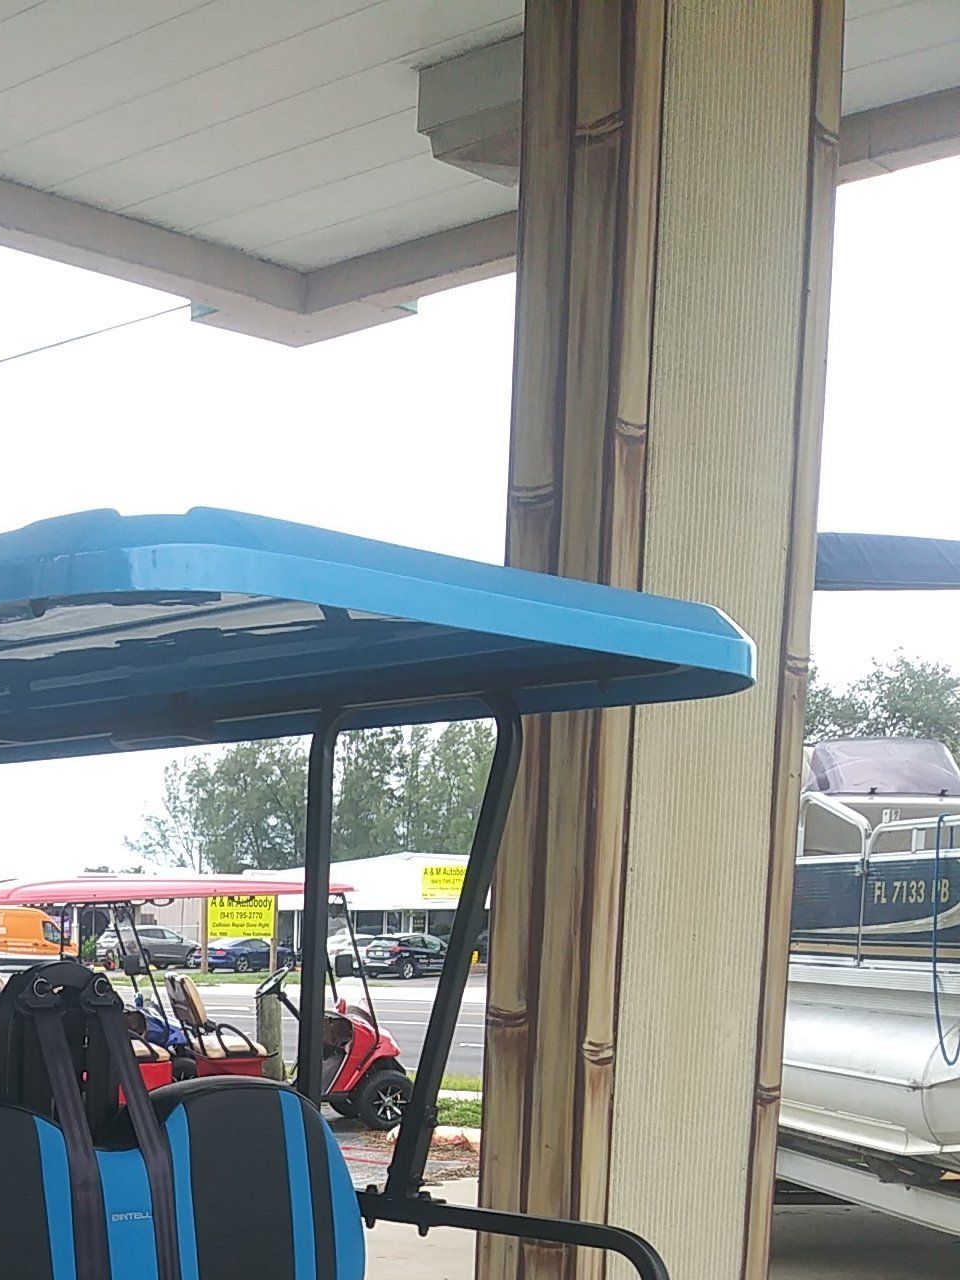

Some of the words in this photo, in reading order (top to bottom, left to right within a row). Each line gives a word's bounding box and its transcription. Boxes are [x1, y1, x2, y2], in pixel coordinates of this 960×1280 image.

[874, 881, 887, 904] FL
[892, 880, 925, 904] 7133
[211, 897, 216, 907] A
[219, 897, 224, 907] &
[235, 897, 272, 910] Autobody
[220, 912, 234, 920] (941)
